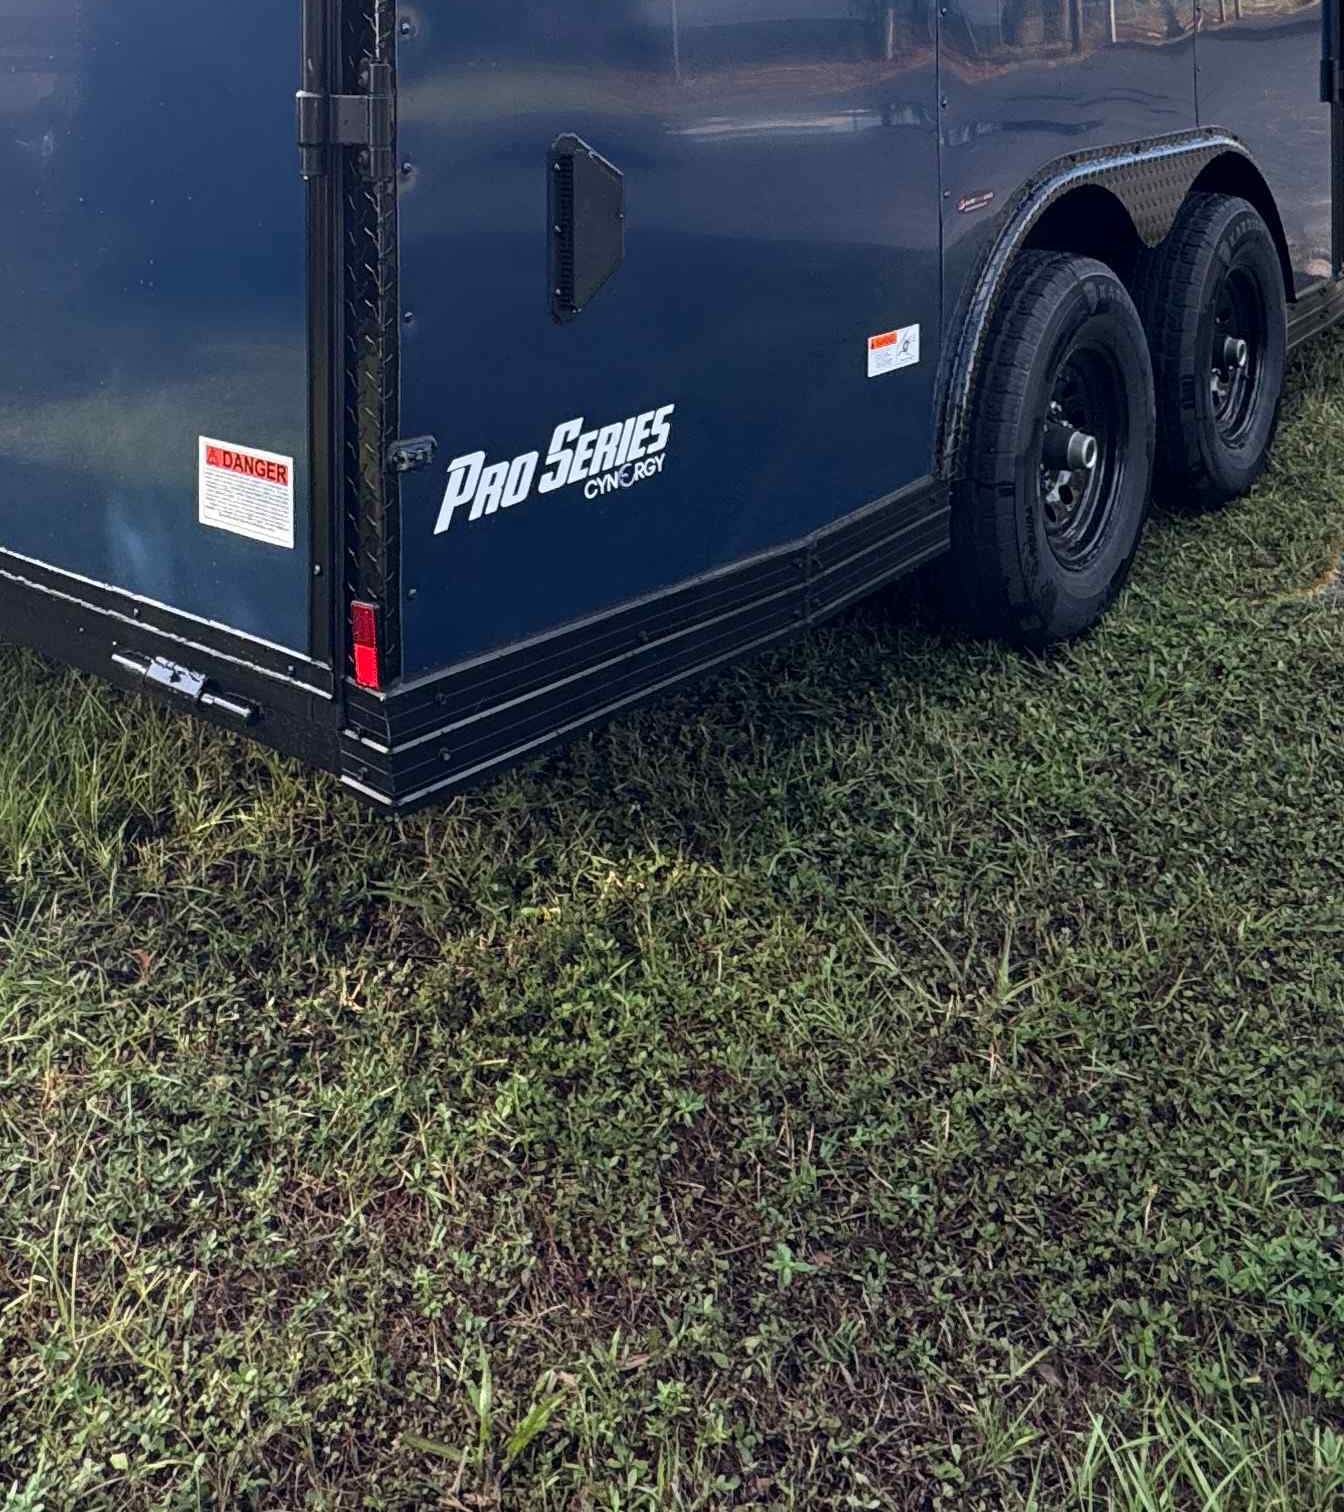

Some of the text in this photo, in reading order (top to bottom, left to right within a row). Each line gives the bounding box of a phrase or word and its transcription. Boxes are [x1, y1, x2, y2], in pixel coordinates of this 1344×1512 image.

[222, 450, 288, 483] DANGER
[433, 403, 675, 535] PRO SERIES
